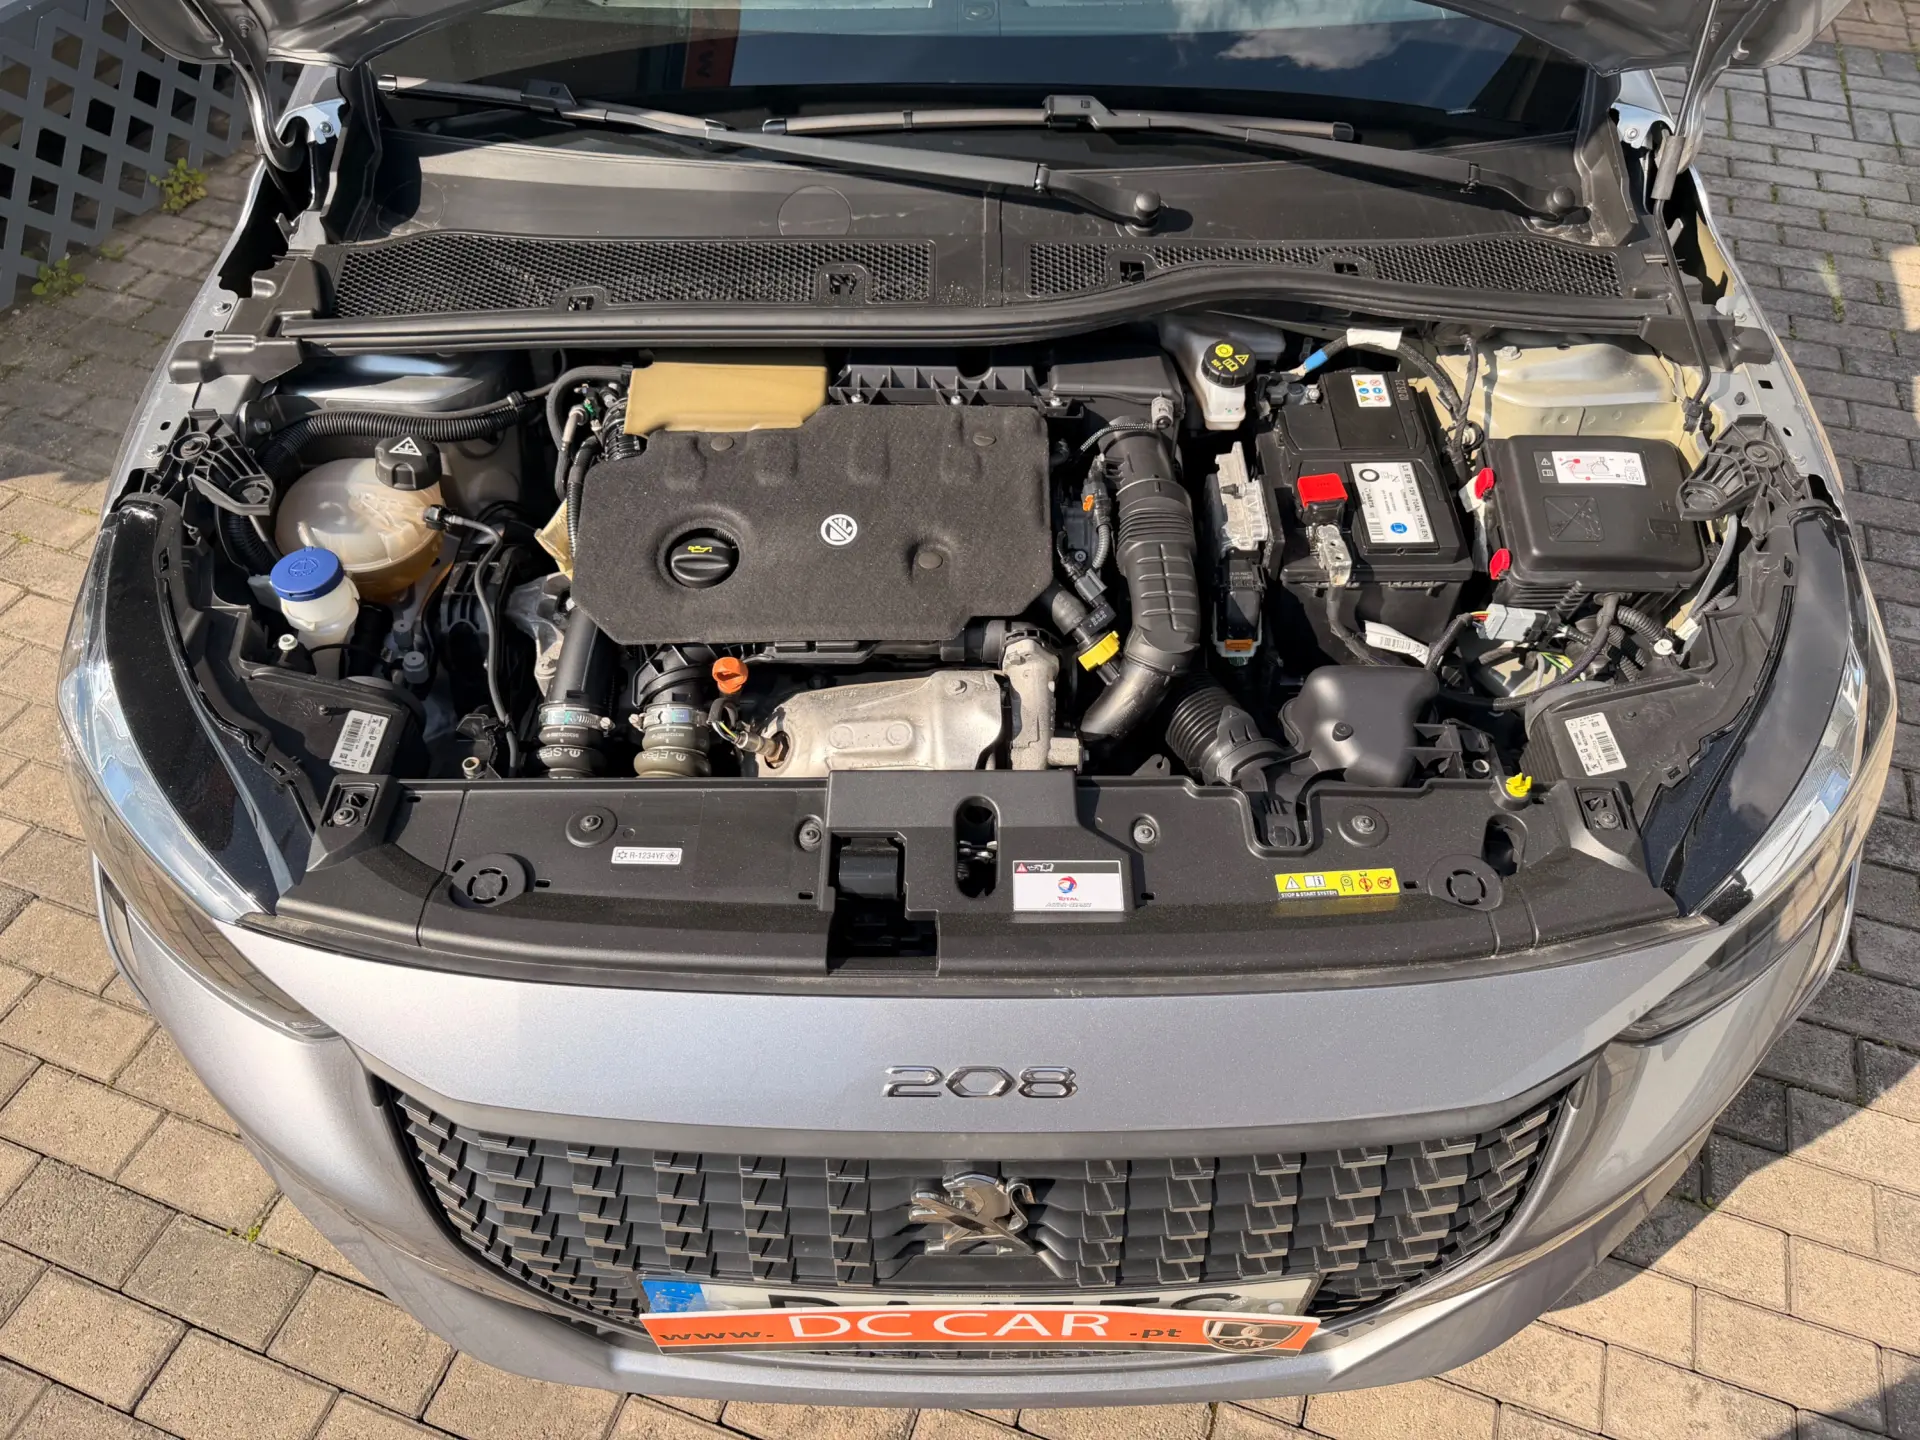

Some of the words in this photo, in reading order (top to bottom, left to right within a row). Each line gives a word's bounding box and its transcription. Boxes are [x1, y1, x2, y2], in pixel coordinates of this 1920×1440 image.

[881, 1065, 1079, 1099] 208
[659, 1331, 775, 1341] www.
[788, 1313, 913, 1338] DC
[933, 1312, 1111, 1337] CAR
[1129, 1327, 1182, 1339] .pt
[1219, 1338, 1265, 1348] CAR
